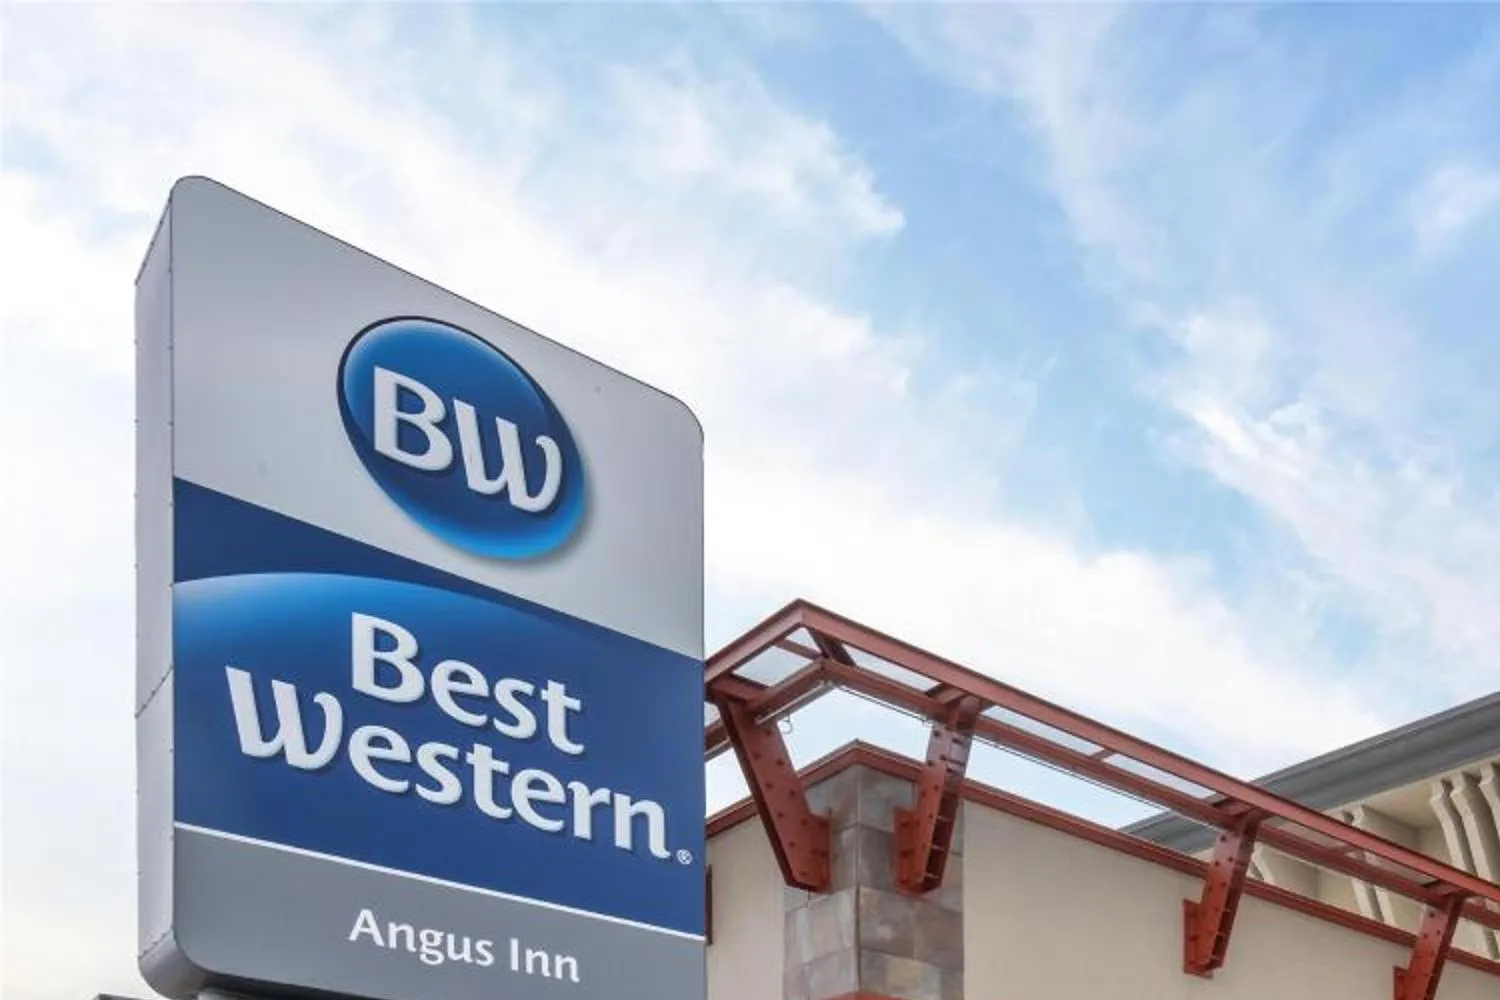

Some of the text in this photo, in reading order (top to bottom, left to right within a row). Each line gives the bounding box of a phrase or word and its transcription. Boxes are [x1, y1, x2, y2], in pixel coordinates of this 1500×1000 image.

[374, 366, 563, 512] BW
[351, 612, 585, 755] Best
[225, 665, 672, 861] Western
[349, 908, 581, 983] Angus Inn
